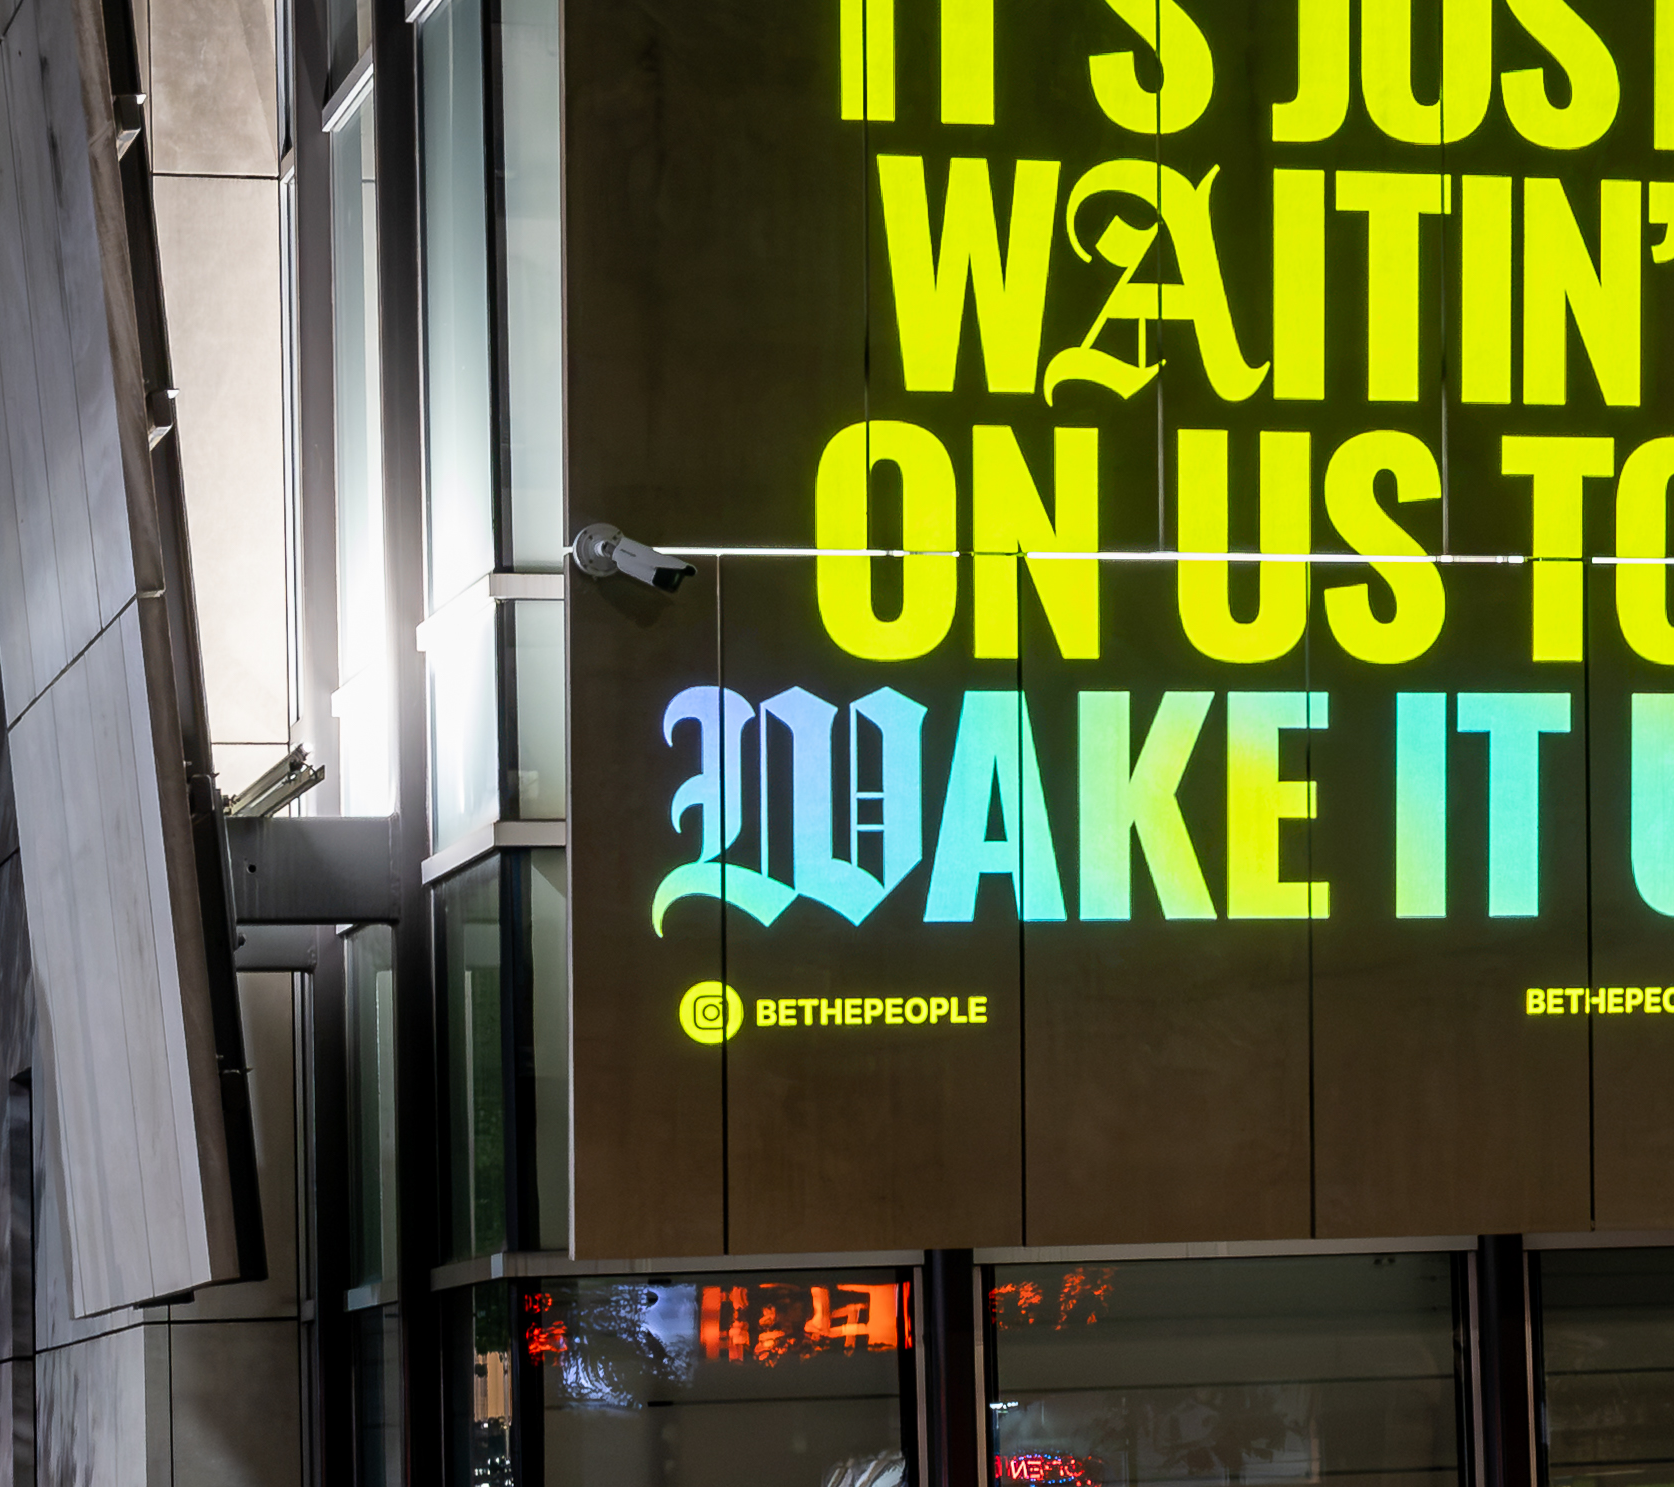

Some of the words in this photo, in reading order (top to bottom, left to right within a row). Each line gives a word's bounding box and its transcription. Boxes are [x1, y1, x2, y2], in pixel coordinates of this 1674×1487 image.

[815, 418, 1102, 662] ON
[1179, 429, 1446, 664] US
[652, 685, 1330, 938] WAKE
[1396, 692, 1571, 919] IT
[756, 996, 987, 1026] BETHEPEOPLE
